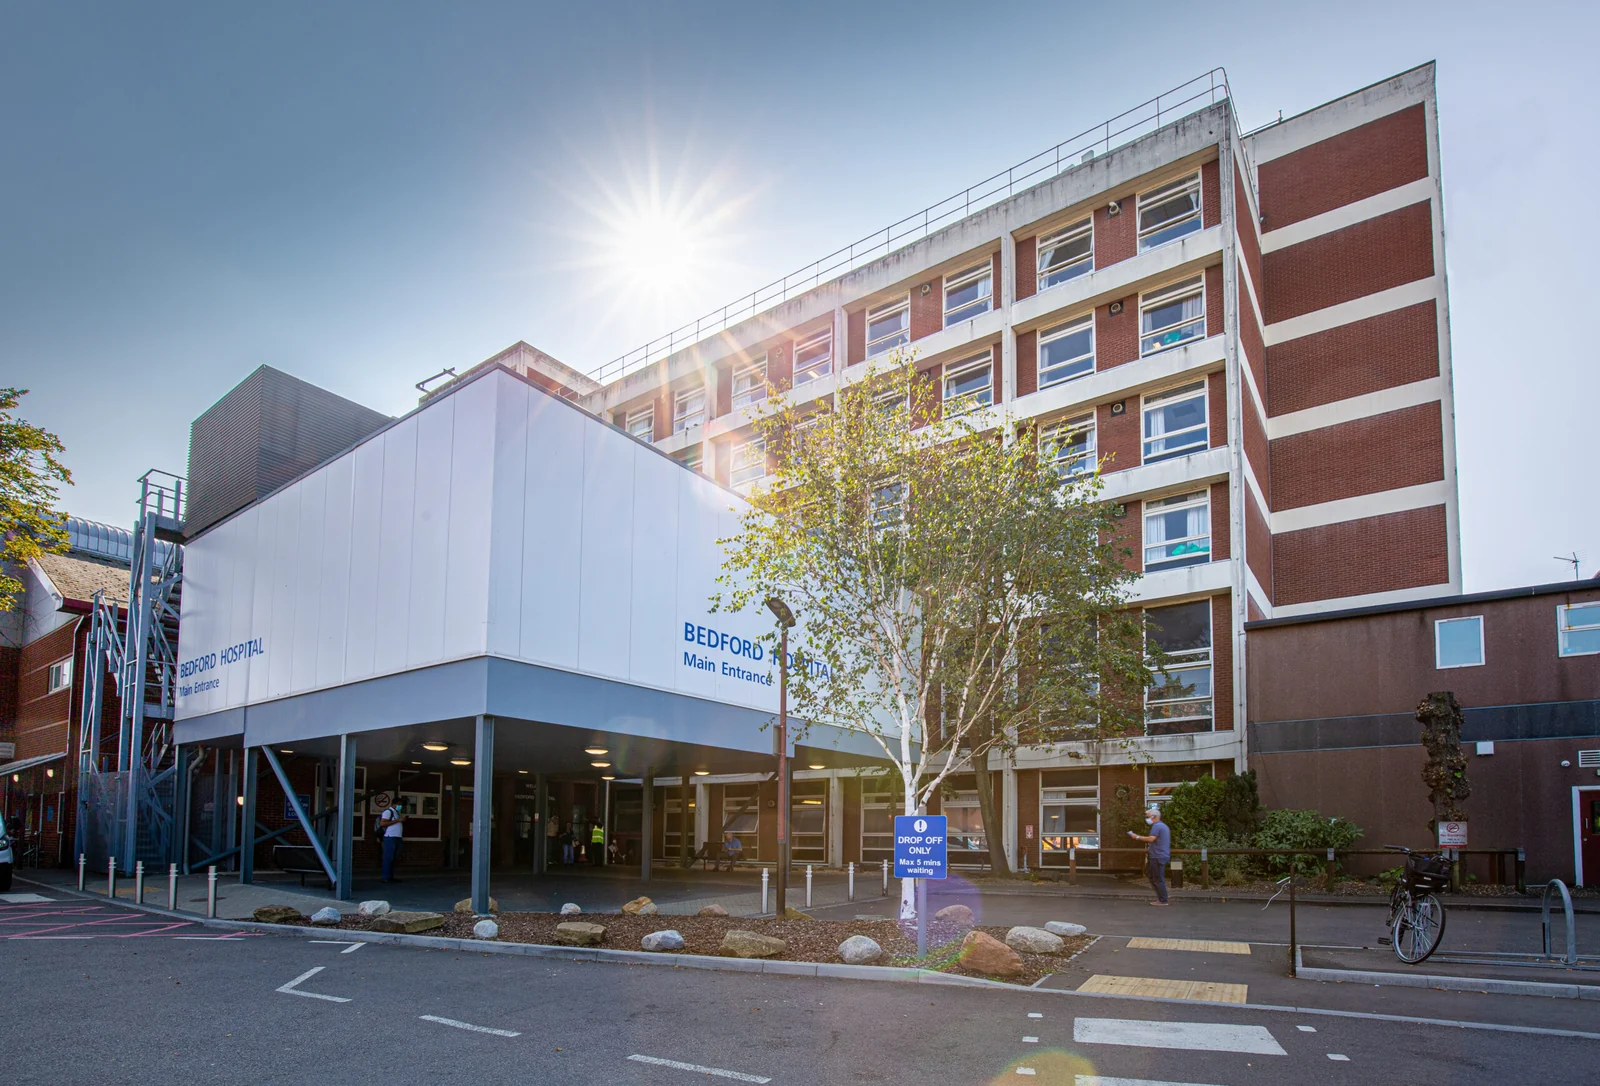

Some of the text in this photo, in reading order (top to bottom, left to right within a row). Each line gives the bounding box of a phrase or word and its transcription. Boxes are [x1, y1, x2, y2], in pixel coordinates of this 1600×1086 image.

[180, 637, 264, 679] BEDFORD HOSPITAL
[684, 622, 836, 682] BEDFORD HOITA
[684, 651, 772, 687] Main Entrance
[179, 678, 220, 698] Main Entrance
[898, 836, 943, 844] DROP OFF
[908, 846, 932, 855] ONLY
[899, 858, 941, 867] Max 5 mins
[907, 867, 934, 876] waiting
